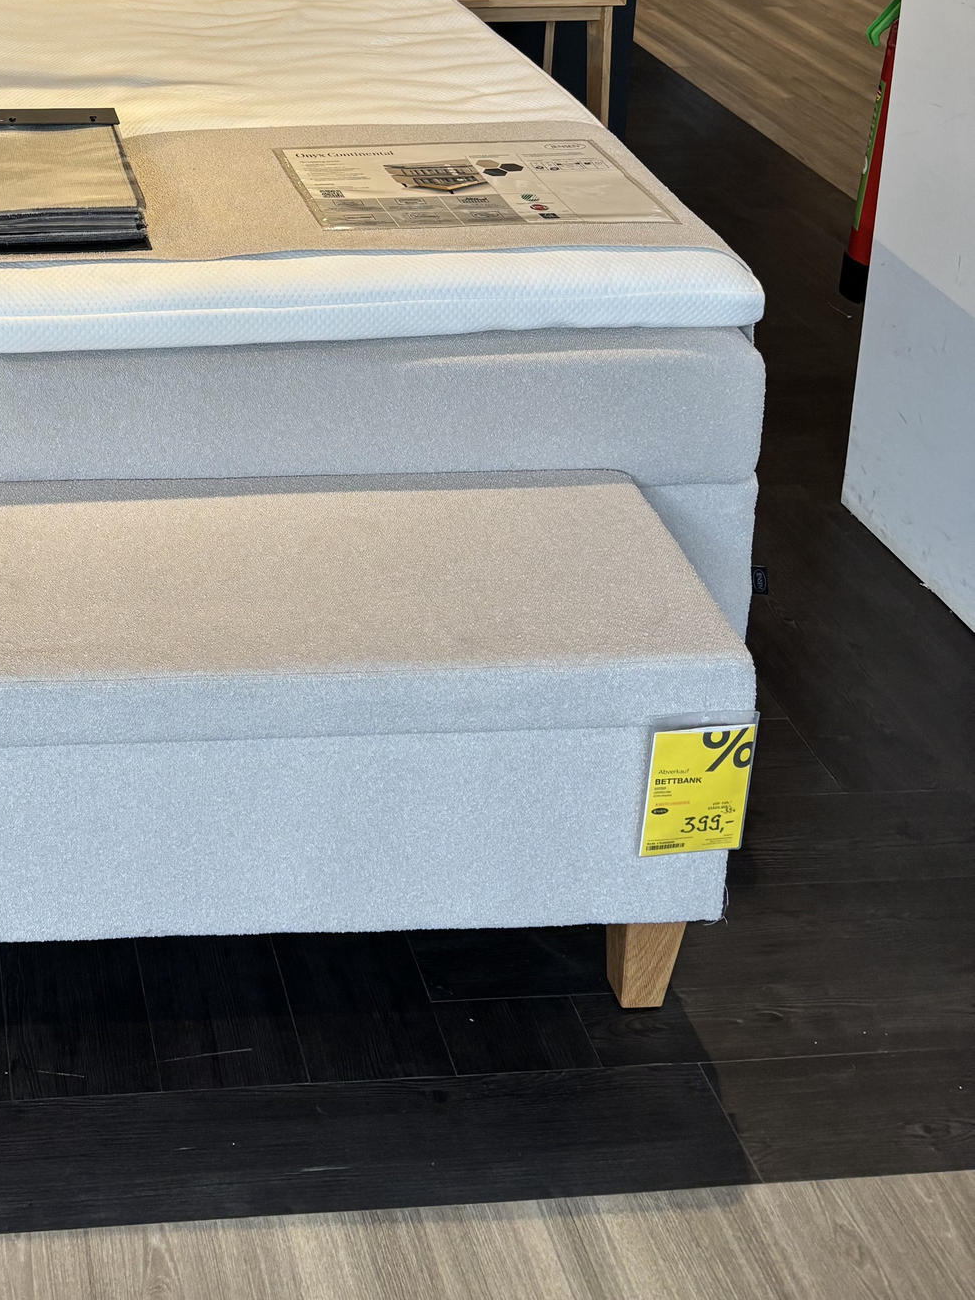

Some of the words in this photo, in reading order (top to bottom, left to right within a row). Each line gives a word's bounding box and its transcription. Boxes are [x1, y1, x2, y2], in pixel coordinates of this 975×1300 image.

[327, 150, 394, 158] Continental
[654, 777, 703, 786] BETTBANK
[680, 814, 735, 834] 399,-
